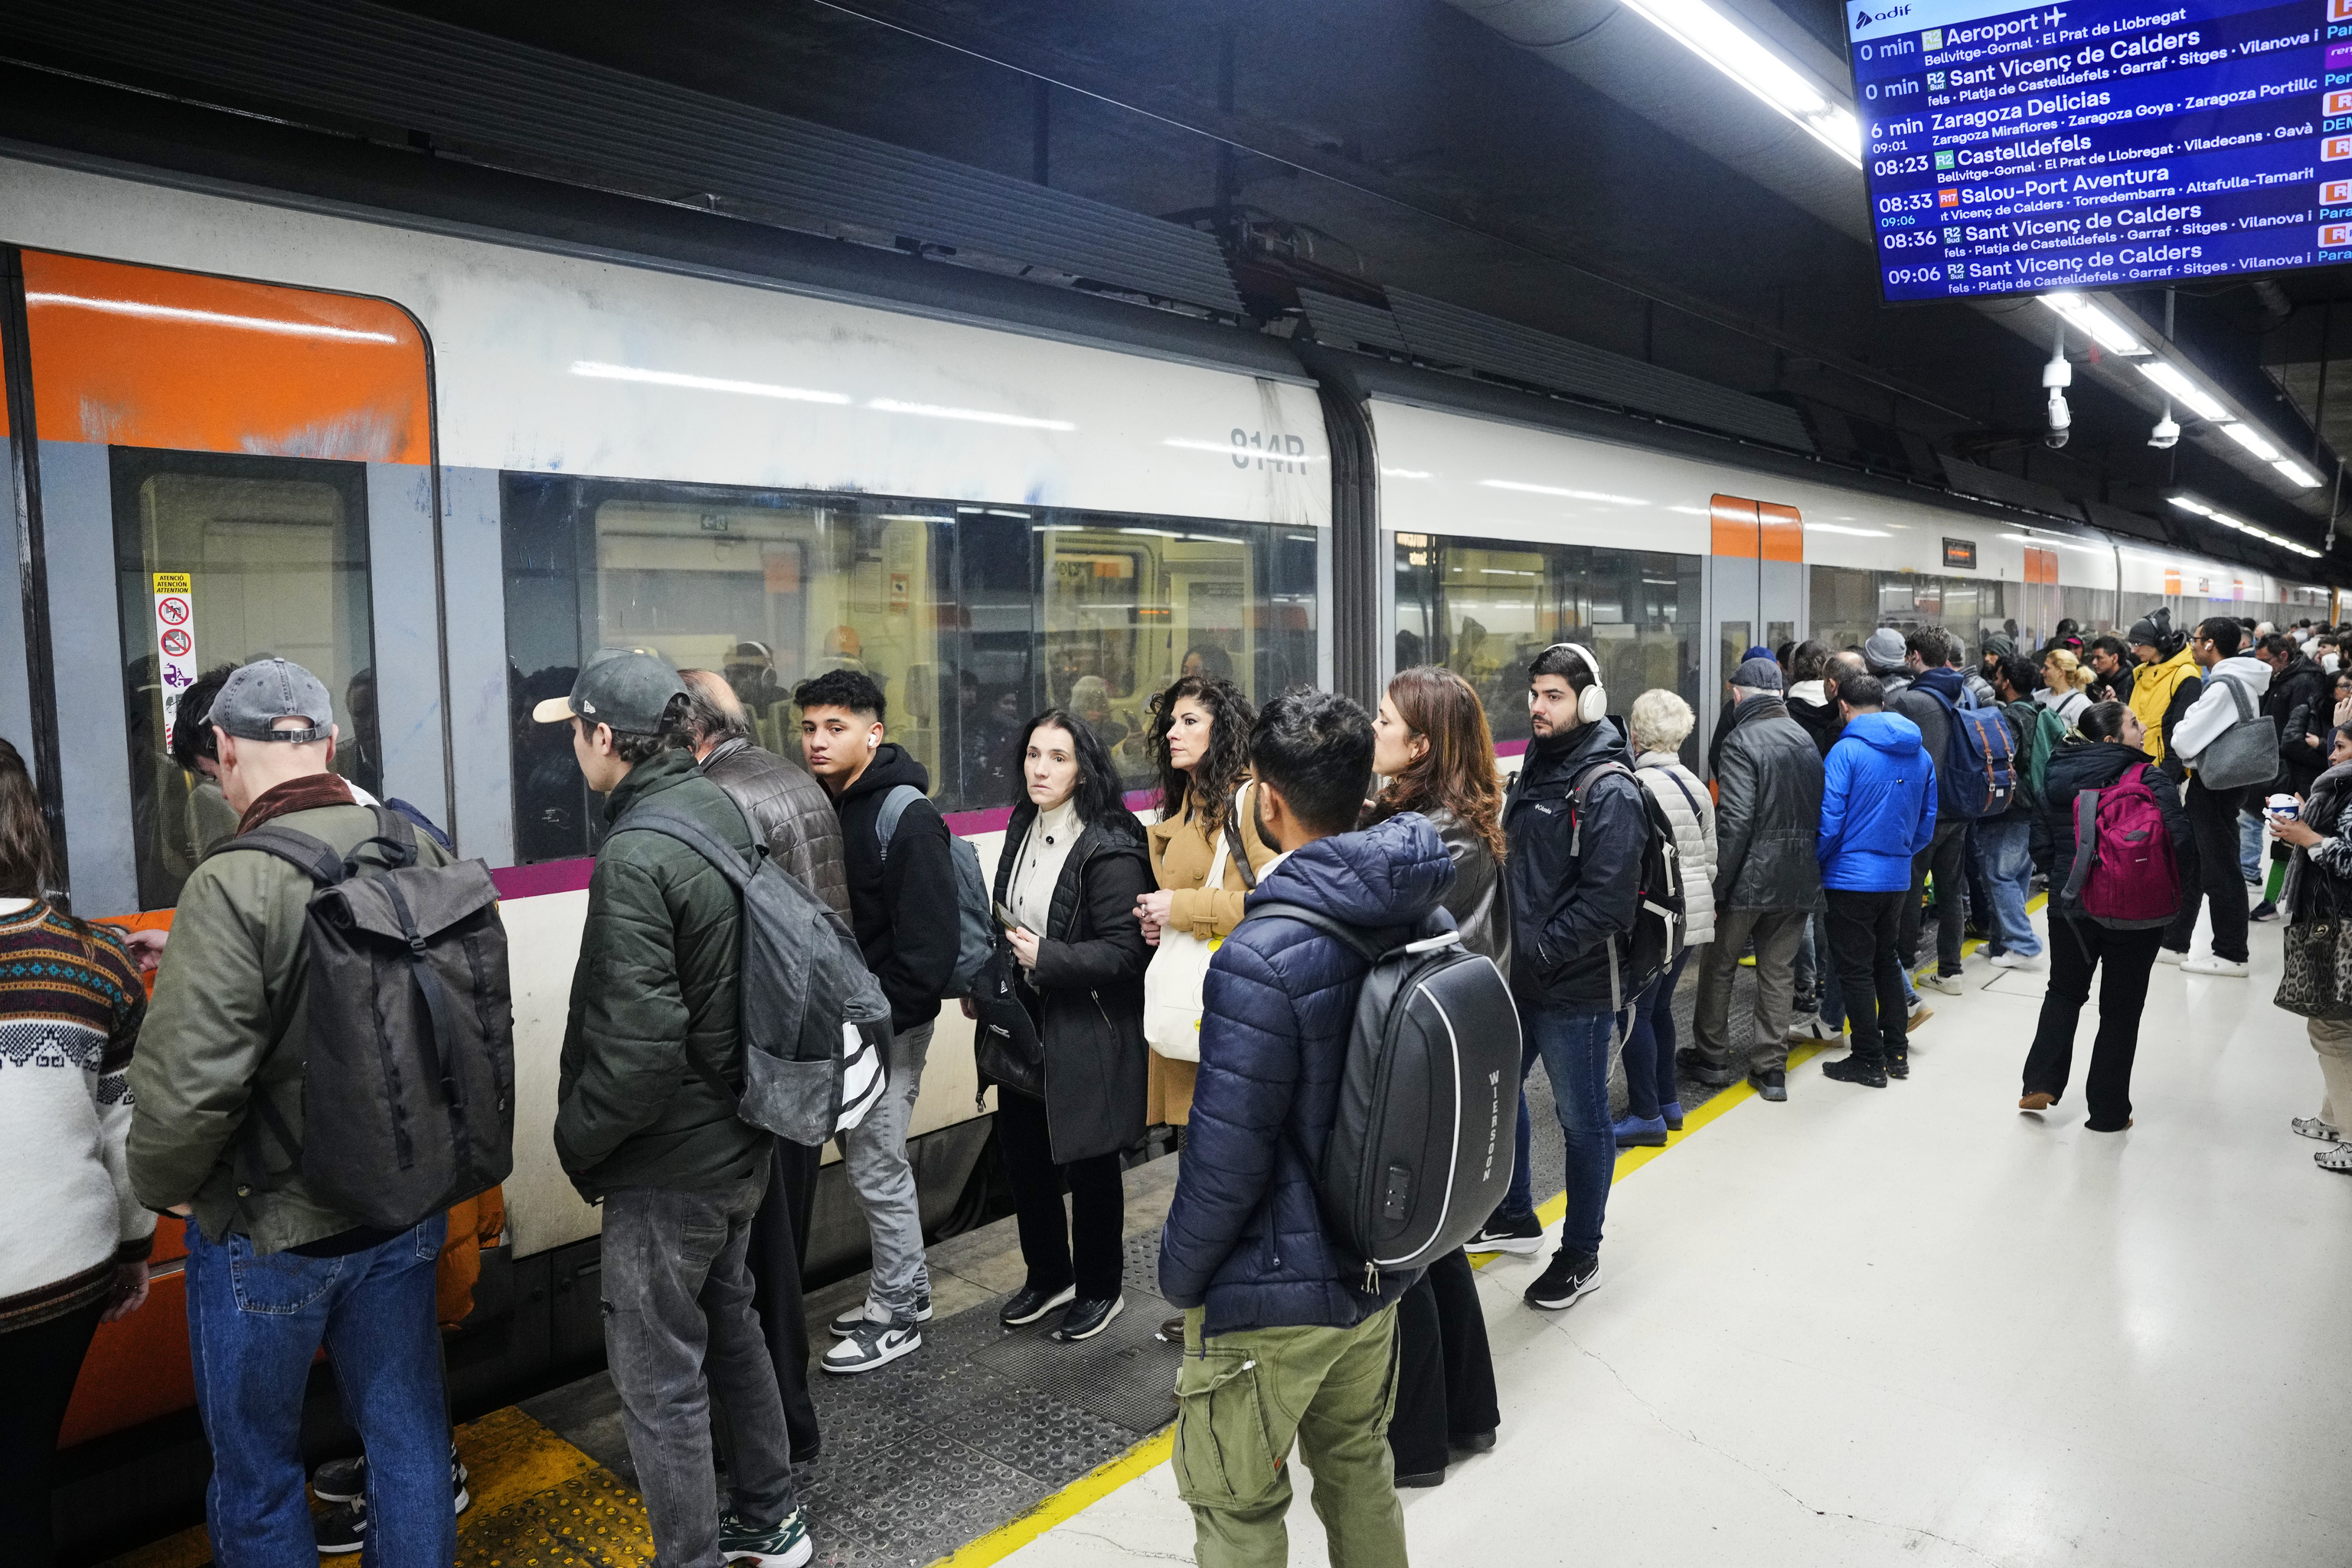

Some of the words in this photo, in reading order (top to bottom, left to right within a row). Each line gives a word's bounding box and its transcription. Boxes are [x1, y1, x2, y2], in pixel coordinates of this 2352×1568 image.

[1875, 4, 1912, 21] adif
[1922, 31, 1941, 44] R2
[1925, 36, 2032, 67] Bellvitge-Gornal
[2043, 32, 2056, 46] El
[2060, 27, 2088, 44] Prat
[2092, 23, 2110, 37] de
[2113, 8, 2187, 33] Llobregat
[1946, 14, 2039, 46] Aeroport
[1860, 45, 1873, 61] 0
[1880, 38, 1914, 58] min
[1924, 42, 1942, 51] Nord
[1950, 65, 1996, 87] Sant
[2000, 54, 2072, 78] Vicenç
[2076, 46, 2105, 65] de
[2110, 31, 2200, 59] Calders
[1959, 86, 1996, 103] Platja
[1998, 82, 2016, 95] de
[2018, 68, 2110, 92] Castelldefels
[2120, 57, 2168, 76] Garraf
[2179, 47, 2228, 66] Sitges
[2239, 32, 2310, 55] Vilanova
[2314, 28, 2319, 41] i
[1926, 71, 1945, 85] R2
[1929, 82, 1945, 91] Sud
[2325, 74, 2352, 87] Per
[1866, 84, 1877, 100] 0
[1884, 79, 1919, 98] min
[1932, 105, 2022, 131] Zaragoza
[2028, 90, 2111, 116] Delicias
[2337, 94, 2352, 108] R
[1871, 122, 1883, 139] 6
[1890, 118, 1923, 136] min
[1932, 131, 1989, 146] Zaragoza
[1991, 119, 2058, 138] Miraflores
[2068, 109, 2132, 127] Zaragoza
[2135, 101, 2174, 119] Goya
[2185, 90, 2256, 110] Zaragoza
[1873, 141, 1908, 154] 09:01
[1937, 164, 2036, 184] Bellvitge-Gornal
[2045, 158, 2057, 170] El
[2060, 154, 2086, 168] Prat
[2090, 152, 2105, 164] de
[2109, 142, 2174, 162] Llobregat
[2184, 129, 2262, 151] Viladecans
[2275, 122, 2313, 139] Gavà
[1957, 133, 2092, 165] Castelldefels
[2336, 140, 2350, 154] R
[1874, 155, 1929, 177] 08:23
[1936, 153, 1954, 165] R2
[1962, 178, 2068, 204] Salou-Port
[2073, 168, 2169, 191] Aventura
[2334, 185, 2347, 198] R
[1879, 193, 1933, 213] 08:33
[1940, 193, 1957, 203] R17
[1951, 207, 1992, 221] Vicenç
[1995, 205, 2011, 216] de
[2014, 200, 2063, 214] Calders
[2073, 187, 2175, 207] Torredembarra
[1881, 216, 1916, 227] 09:06
[1965, 223, 2009, 241] Sant
[2013, 216, 2081, 237] Vicenç
[2086, 213, 2112, 229] de
[2117, 204, 2202, 226] Calders
[1884, 231, 1936, 249] 08:36
[1943, 227, 1961, 238] R2
[1975, 243, 2010, 256] Platja
[2012, 241, 2028, 252] de
[2030, 232, 2117, 249] Castelldefels
[2128, 226, 2171, 240] Garraf
[2182, 220, 2228, 236] Sitges
[2239, 212, 2304, 228] Vilanova
[2308, 211, 2312, 221] i
[2332, 228, 2345, 240] R
[1947, 263, 1965, 274] R2
[1969, 261, 2012, 278] Sant
[2016, 255, 2084, 273] Vicenç
[2088, 251, 2114, 266] de
[2118, 245, 2203, 265] Calders
[1978, 279, 2013, 292] Platja
[2015, 278, 2030, 288] de
[2034, 271, 2118, 286] Castelldefels
[2128, 266, 2173, 279] Garraf
[2184, 261, 2228, 275] Sitges
[2239, 254, 2303, 270] Vilanova
[2307, 252, 2311, 263] i
[1888, 267, 1941, 285] 09:06
[1230, 428, 1307, 475] 814R
[1482, 1070, 1500, 1182] WIERSOON
